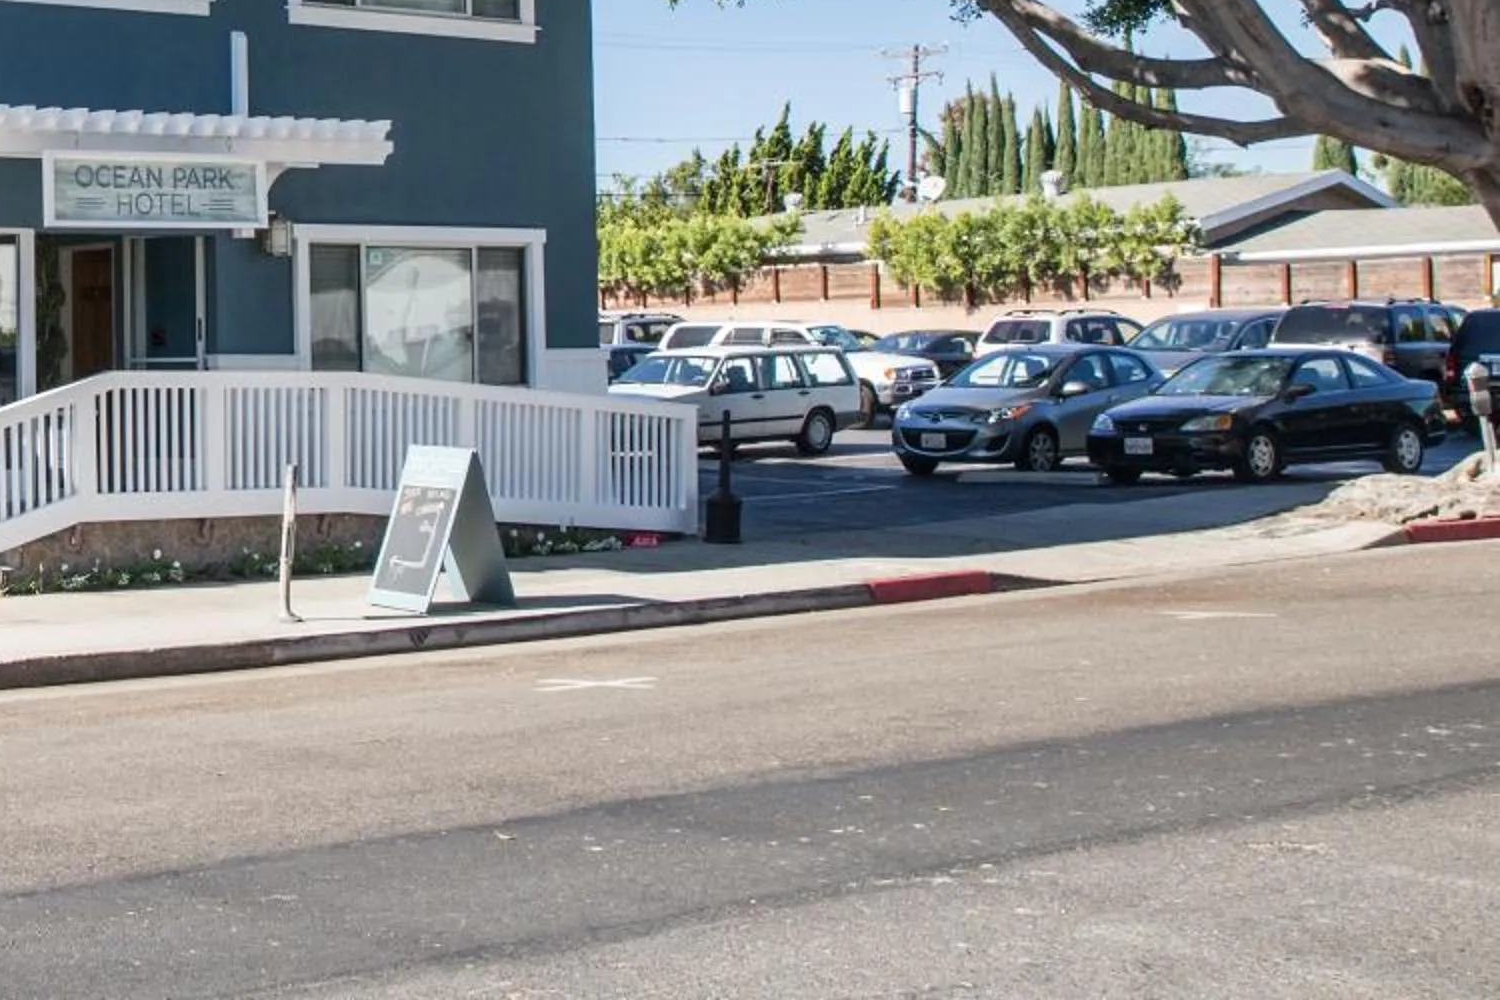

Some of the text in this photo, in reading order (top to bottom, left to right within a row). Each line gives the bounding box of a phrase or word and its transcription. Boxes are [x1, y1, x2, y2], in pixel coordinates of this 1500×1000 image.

[73, 164, 235, 190] OCEAN PARK
[116, 192, 200, 216] HOTEL
